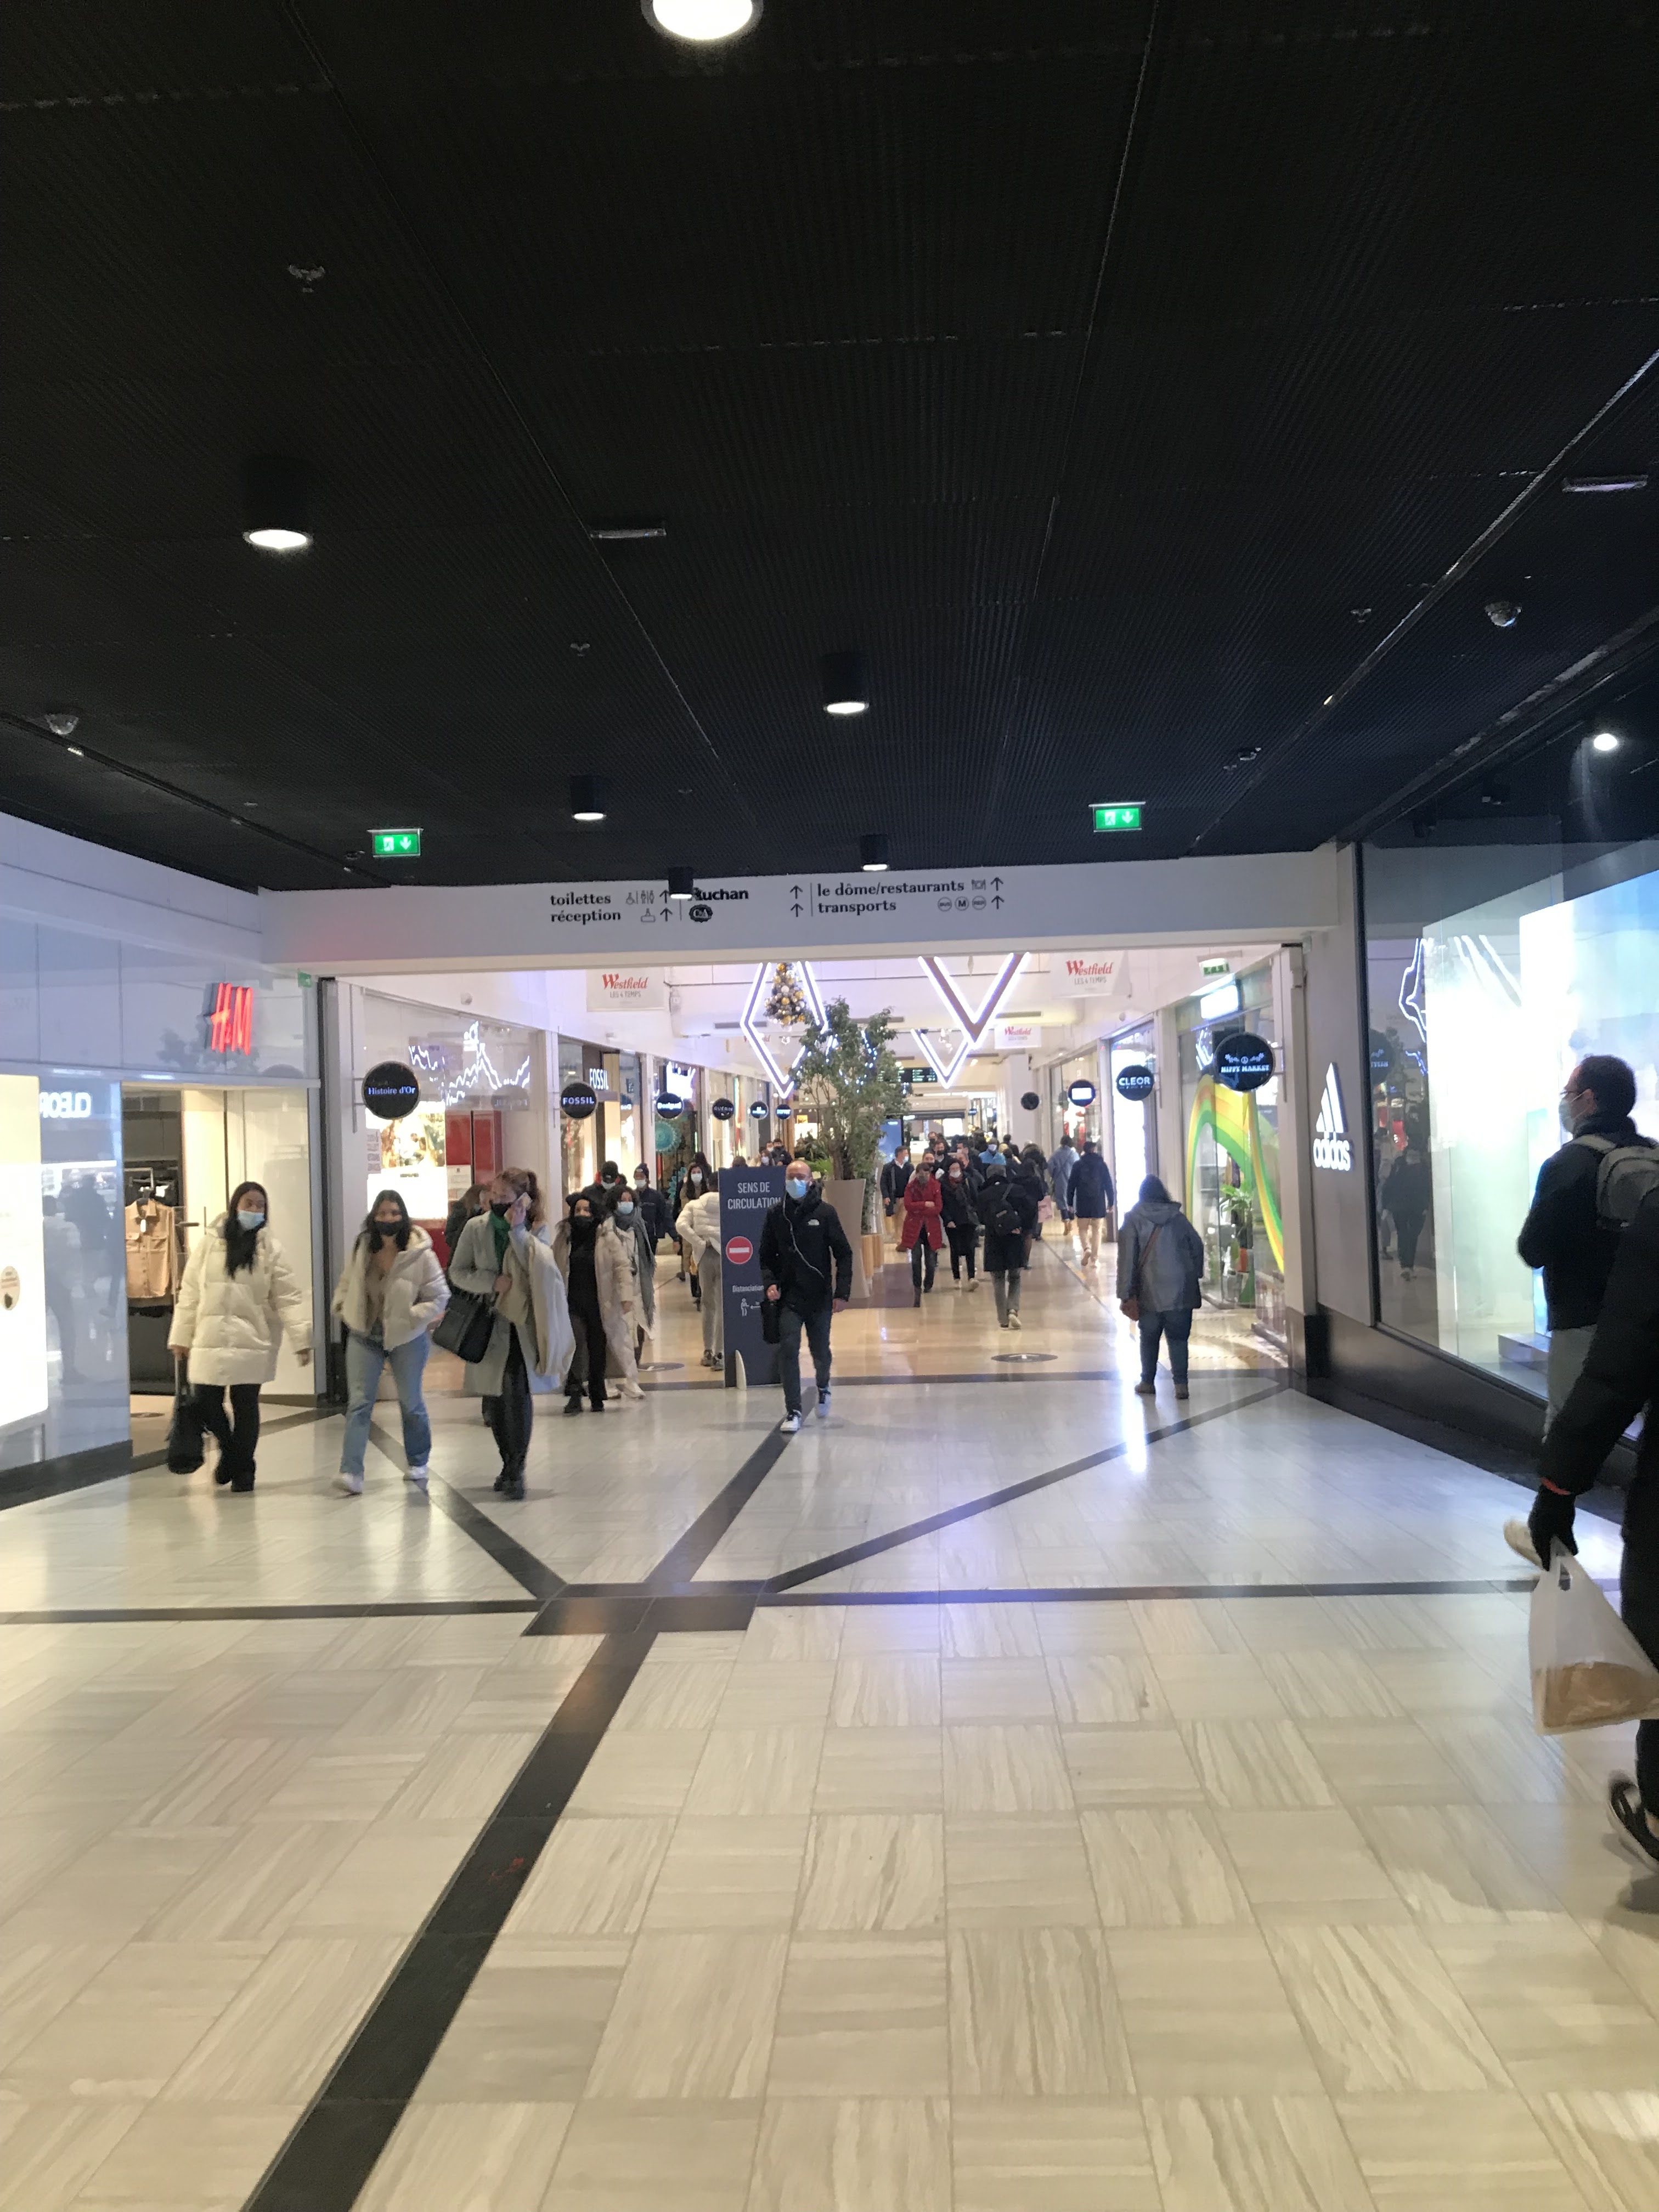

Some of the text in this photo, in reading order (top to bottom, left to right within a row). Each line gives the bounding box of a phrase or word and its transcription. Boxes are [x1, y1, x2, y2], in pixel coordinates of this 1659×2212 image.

[817, 881, 965, 896] le dôme/restaurants
[550, 891, 611, 906] toilettes
[818, 900, 897, 916] transports
[550, 909, 621, 926] réception
[1065, 960, 1114, 975] Westfield
[602, 973, 649, 989] Westfield
[589, 1068, 609, 1090] FOSSIL
[1119, 1076, 1150, 1086] CLEOR
[368, 1086, 416, 1095] Histoire d'Or
[563, 1096, 594, 1105] FOSSIL
[1313, 1131, 1351, 1171] adidas
[737, 1182, 770, 1193] SENS DE
